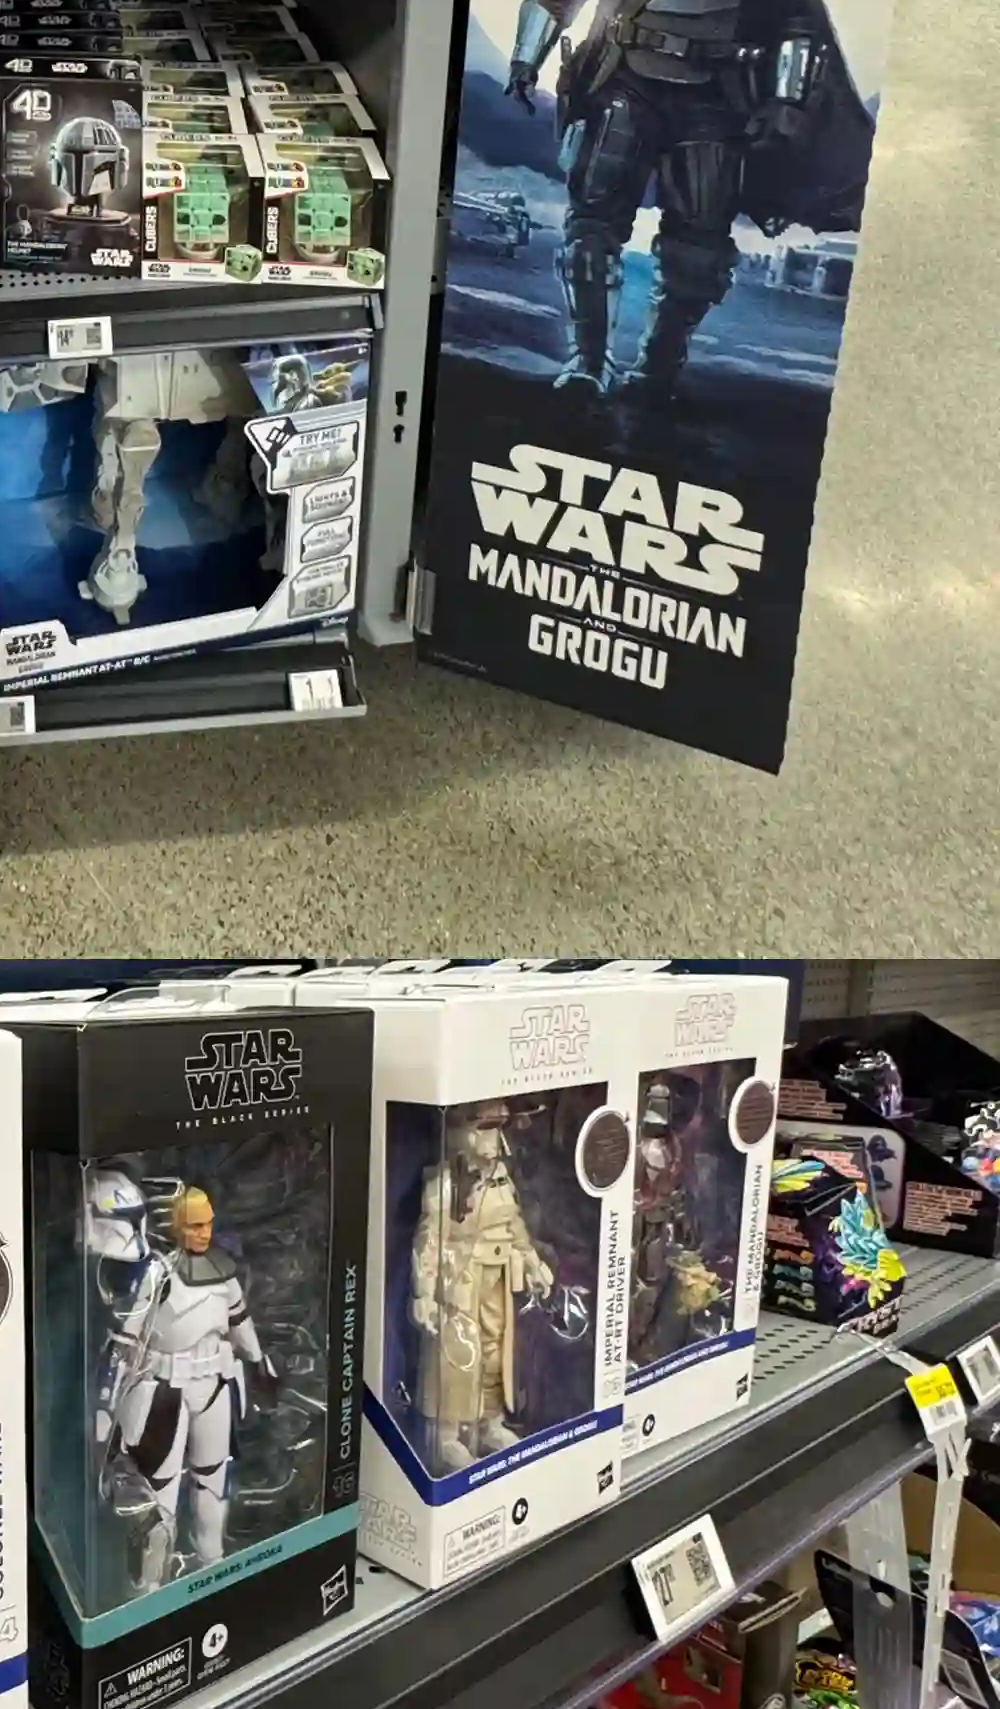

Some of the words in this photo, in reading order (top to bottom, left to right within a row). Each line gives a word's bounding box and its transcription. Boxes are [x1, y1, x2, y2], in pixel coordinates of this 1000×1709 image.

[145, 205, 158, 252] CUBERS
[266, 206, 279, 254] CUBERS
[471, 443, 765, 553] STAR
[471, 479, 762, 596] WARS
[589, 563, 621, 580] THE
[468, 543, 747, 658] MANDALORIAN
[583, 617, 618, 633] AND
[527, 613, 669, 690] GROGU
[184, 1028, 303, 1072] STAR
[184, 1064, 303, 1112] WARS
[175, 1118, 201, 1130] THE
[212, 1112, 253, 1126] BLACK
[264, 1105, 310, 1119] SERIES
[748, 1164, 763, 1264] MANDALORIAN
[607, 1210, 620, 1280] REMNANT
[344, 1264, 358, 1304] REX
[616, 1255, 627, 1315] DRIVER
[341, 1307, 356, 1391] CAPTAIN
[604, 1283, 618, 1366] IMPERIAL
[614, 1318, 625, 1362] AT-RT
[340, 1394, 353, 1460] CLONE
[187, 1577, 213, 1594] STAR
[213, 1565, 244, 1584] WARS:
[244, 1544, 284, 1569] AHSOKA
[127, 1647, 185, 1685] WARNING:
